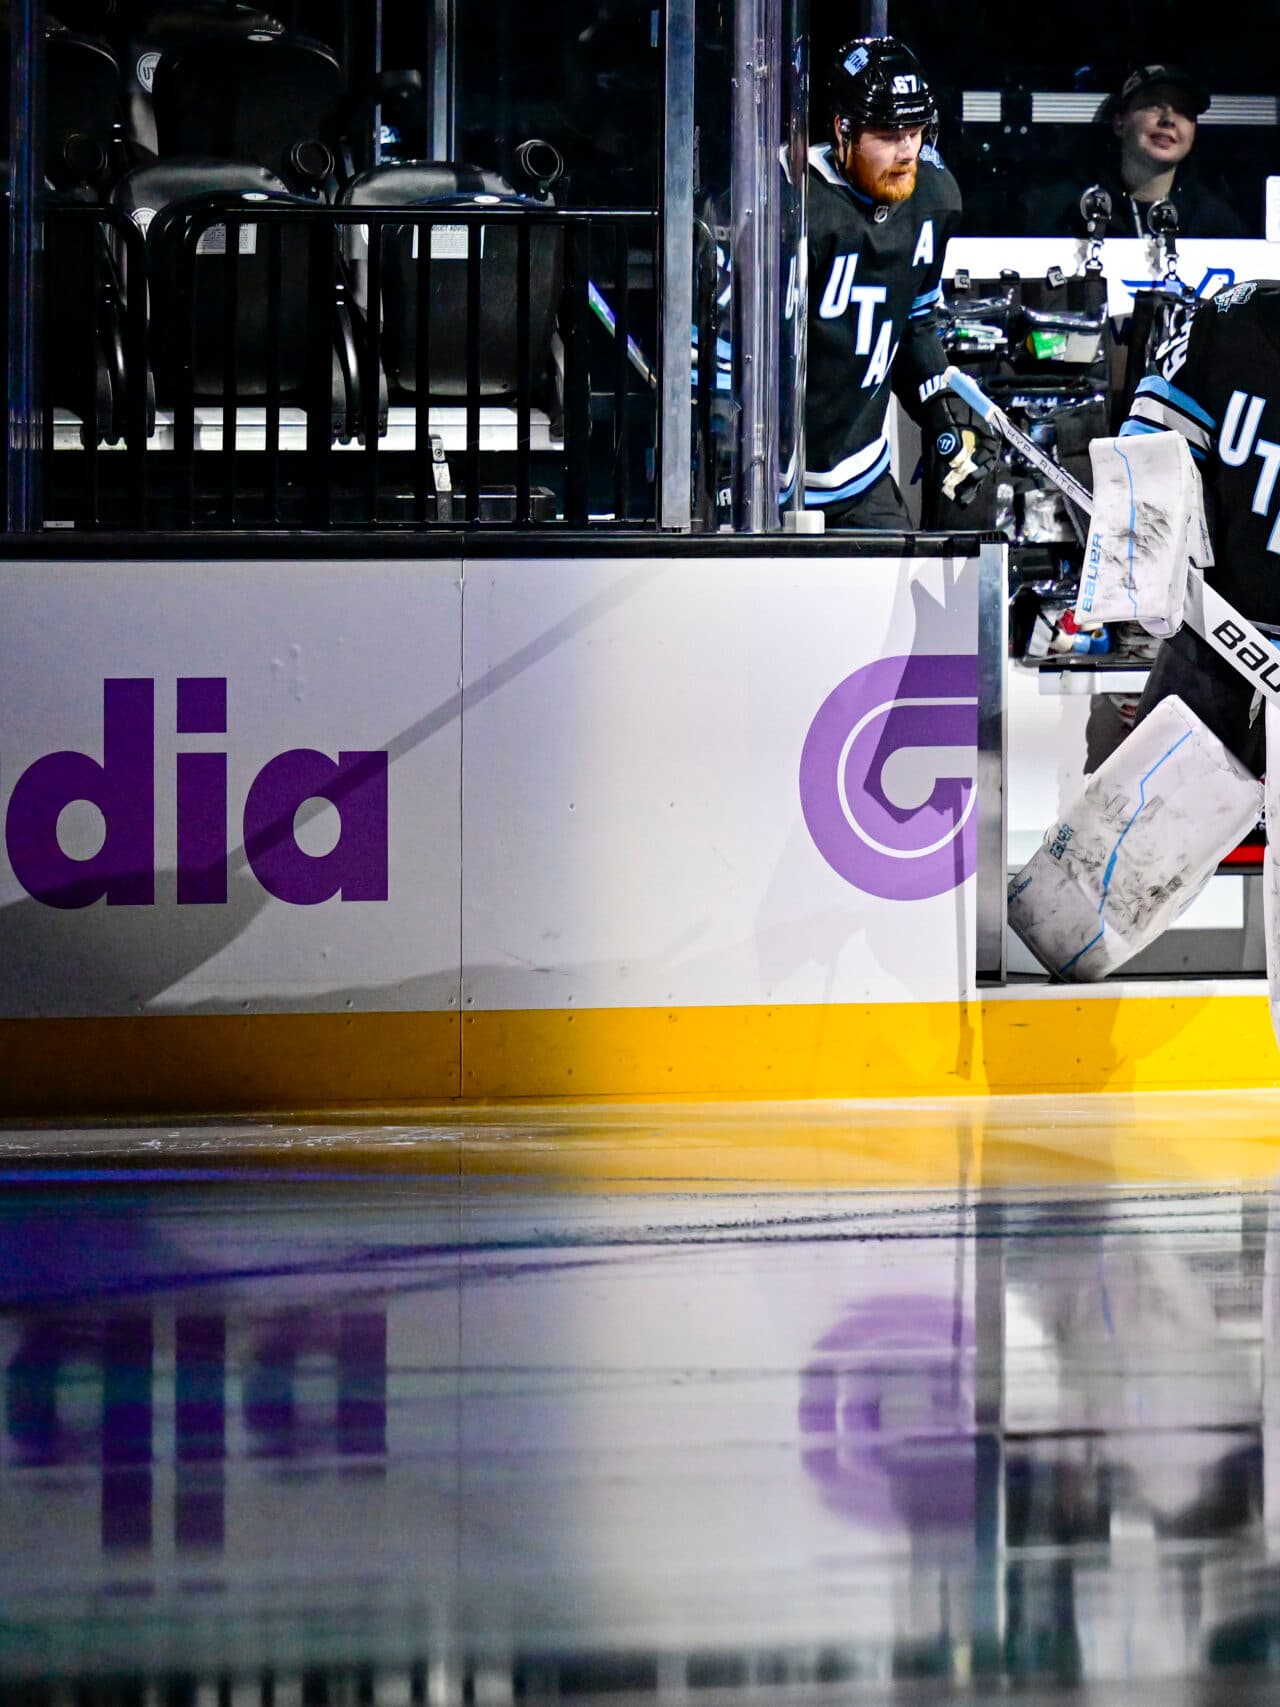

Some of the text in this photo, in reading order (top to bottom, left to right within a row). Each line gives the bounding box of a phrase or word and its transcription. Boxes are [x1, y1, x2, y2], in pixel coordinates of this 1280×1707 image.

[912, 219, 934, 267] A
[819, 254, 899, 400] UTA
[1081, 532, 1104, 613] BAUER
[5, 677, 389, 910] dia
